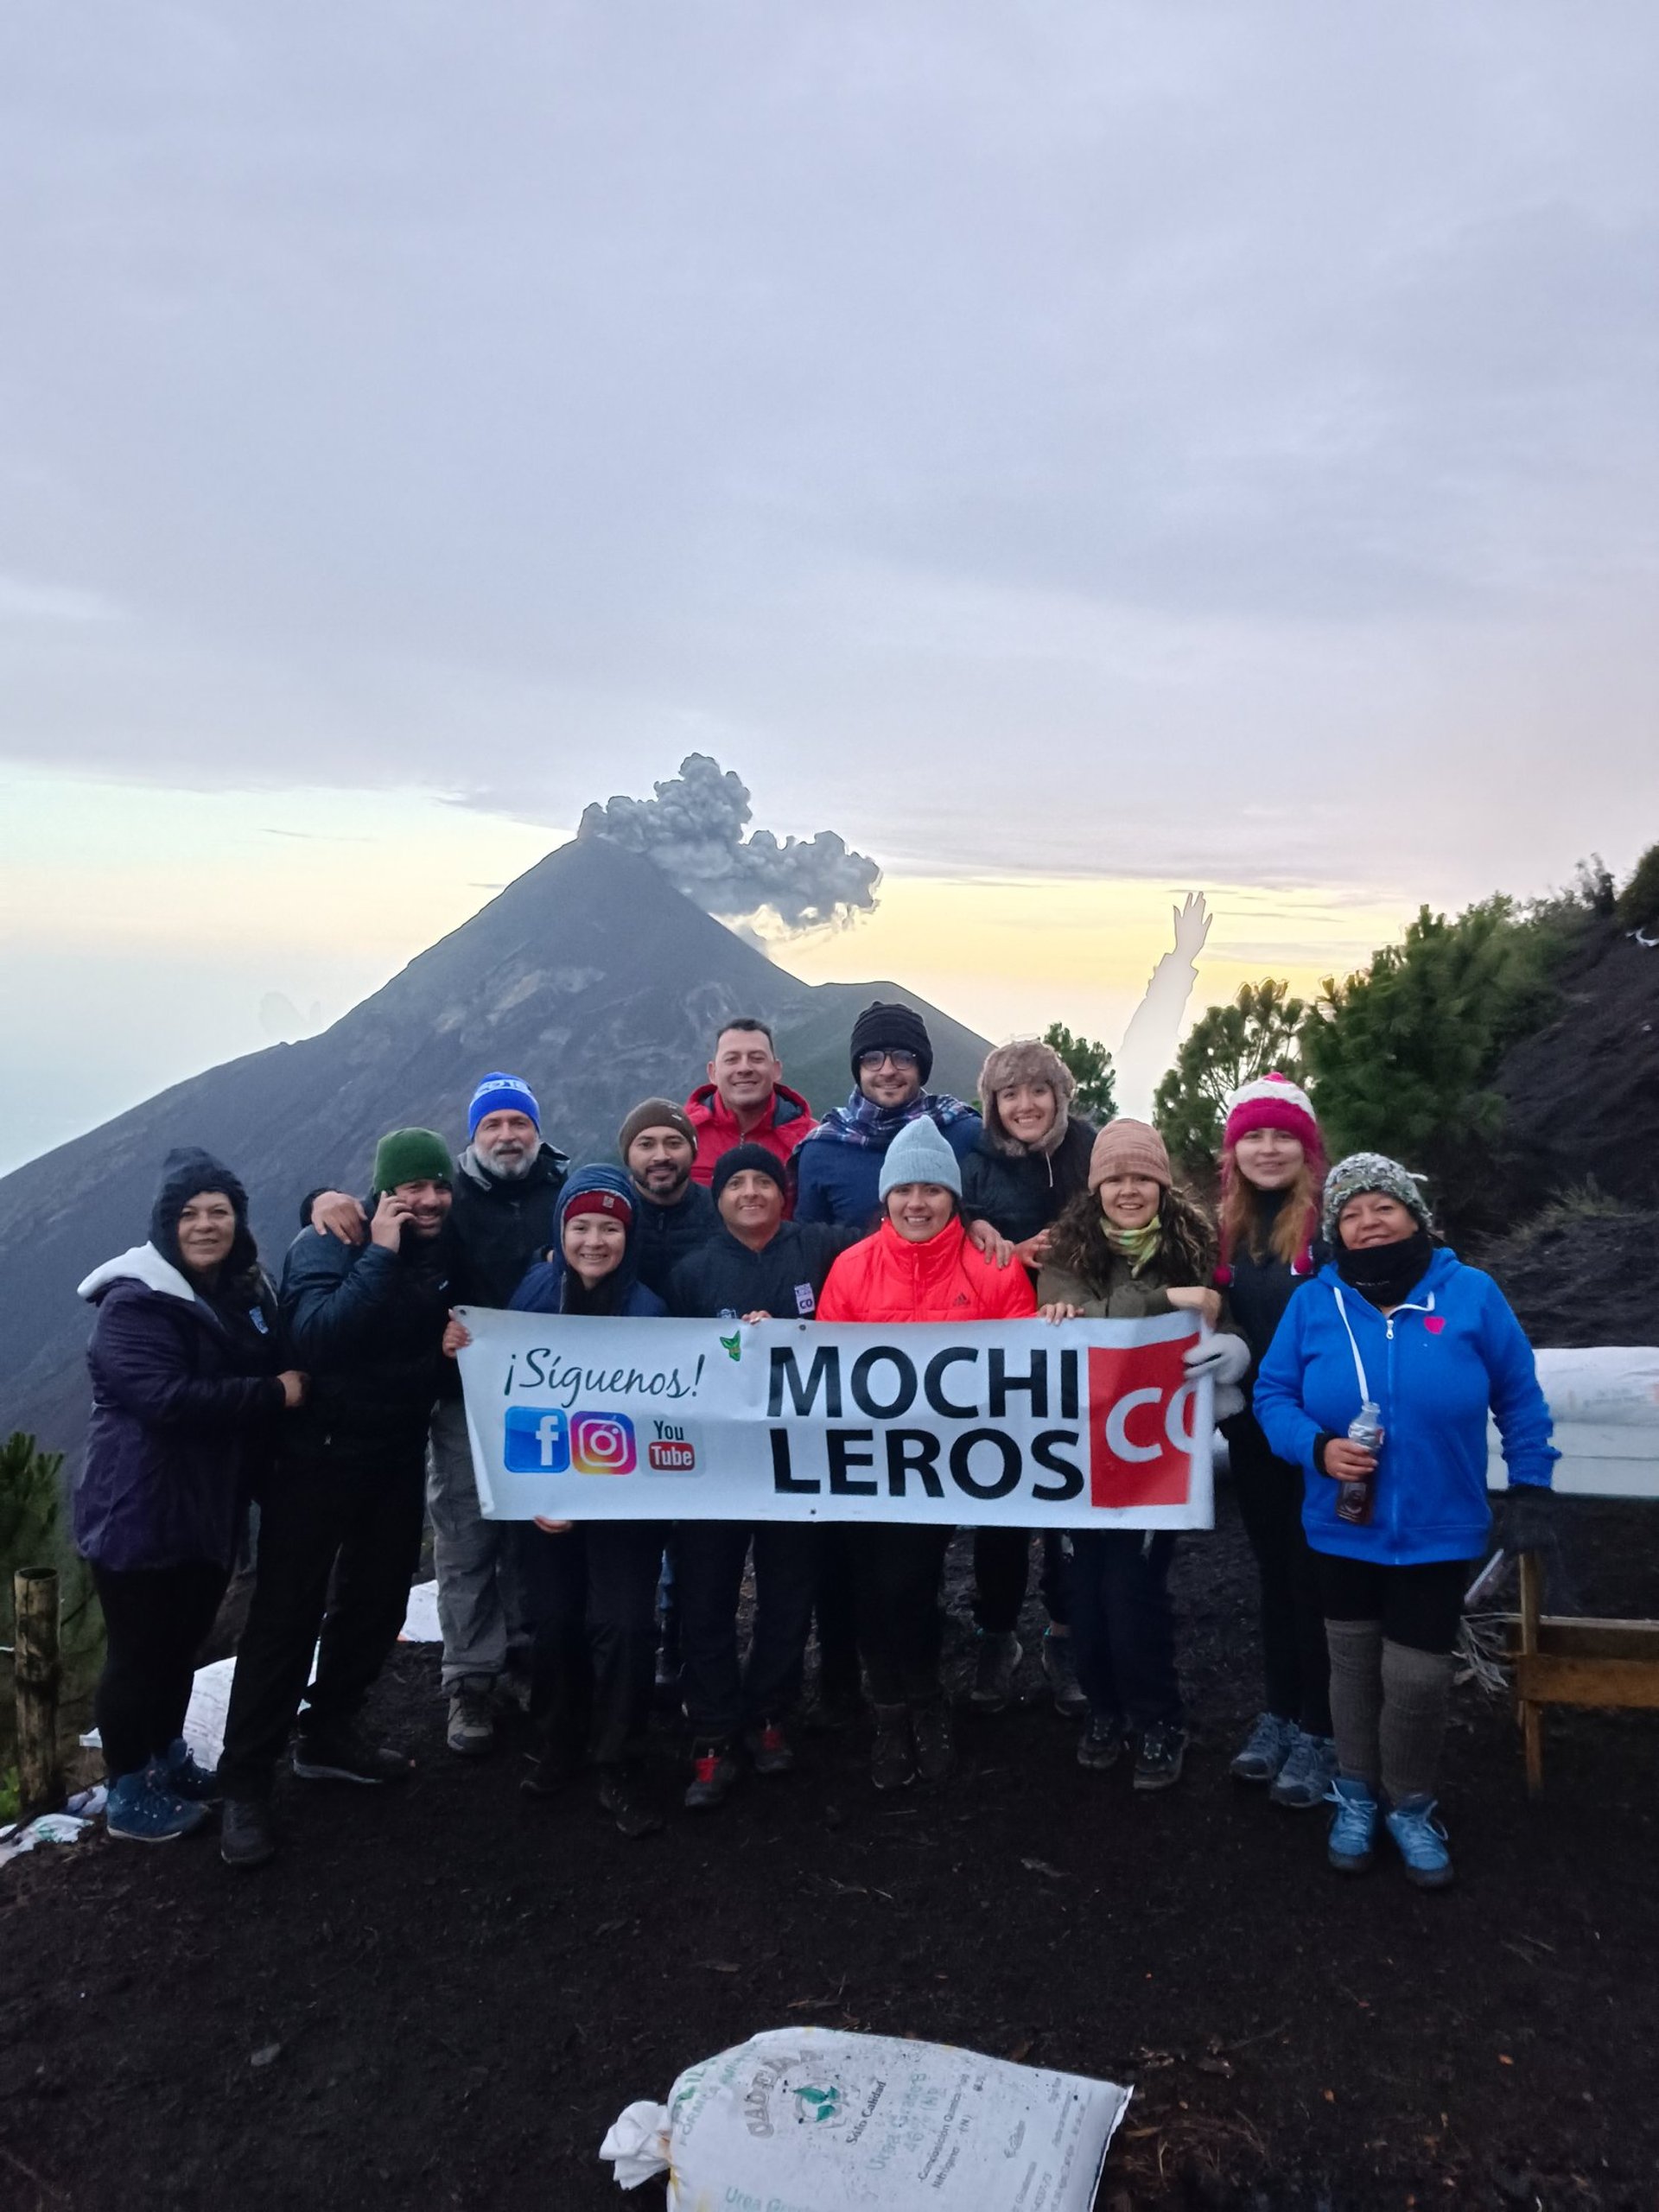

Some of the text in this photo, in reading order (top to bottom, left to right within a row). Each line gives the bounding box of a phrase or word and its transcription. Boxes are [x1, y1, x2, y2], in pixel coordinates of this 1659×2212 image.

[503, 1347, 706, 1409] ¡Síguenos!
[766, 1345, 1079, 1420] MOCHI
[653, 1420, 685, 1441] You
[651, 1445, 693, 1467] Tube
[768, 1427, 1085, 1502] LEROS
[861, 2080, 887, 2118] Calidad
